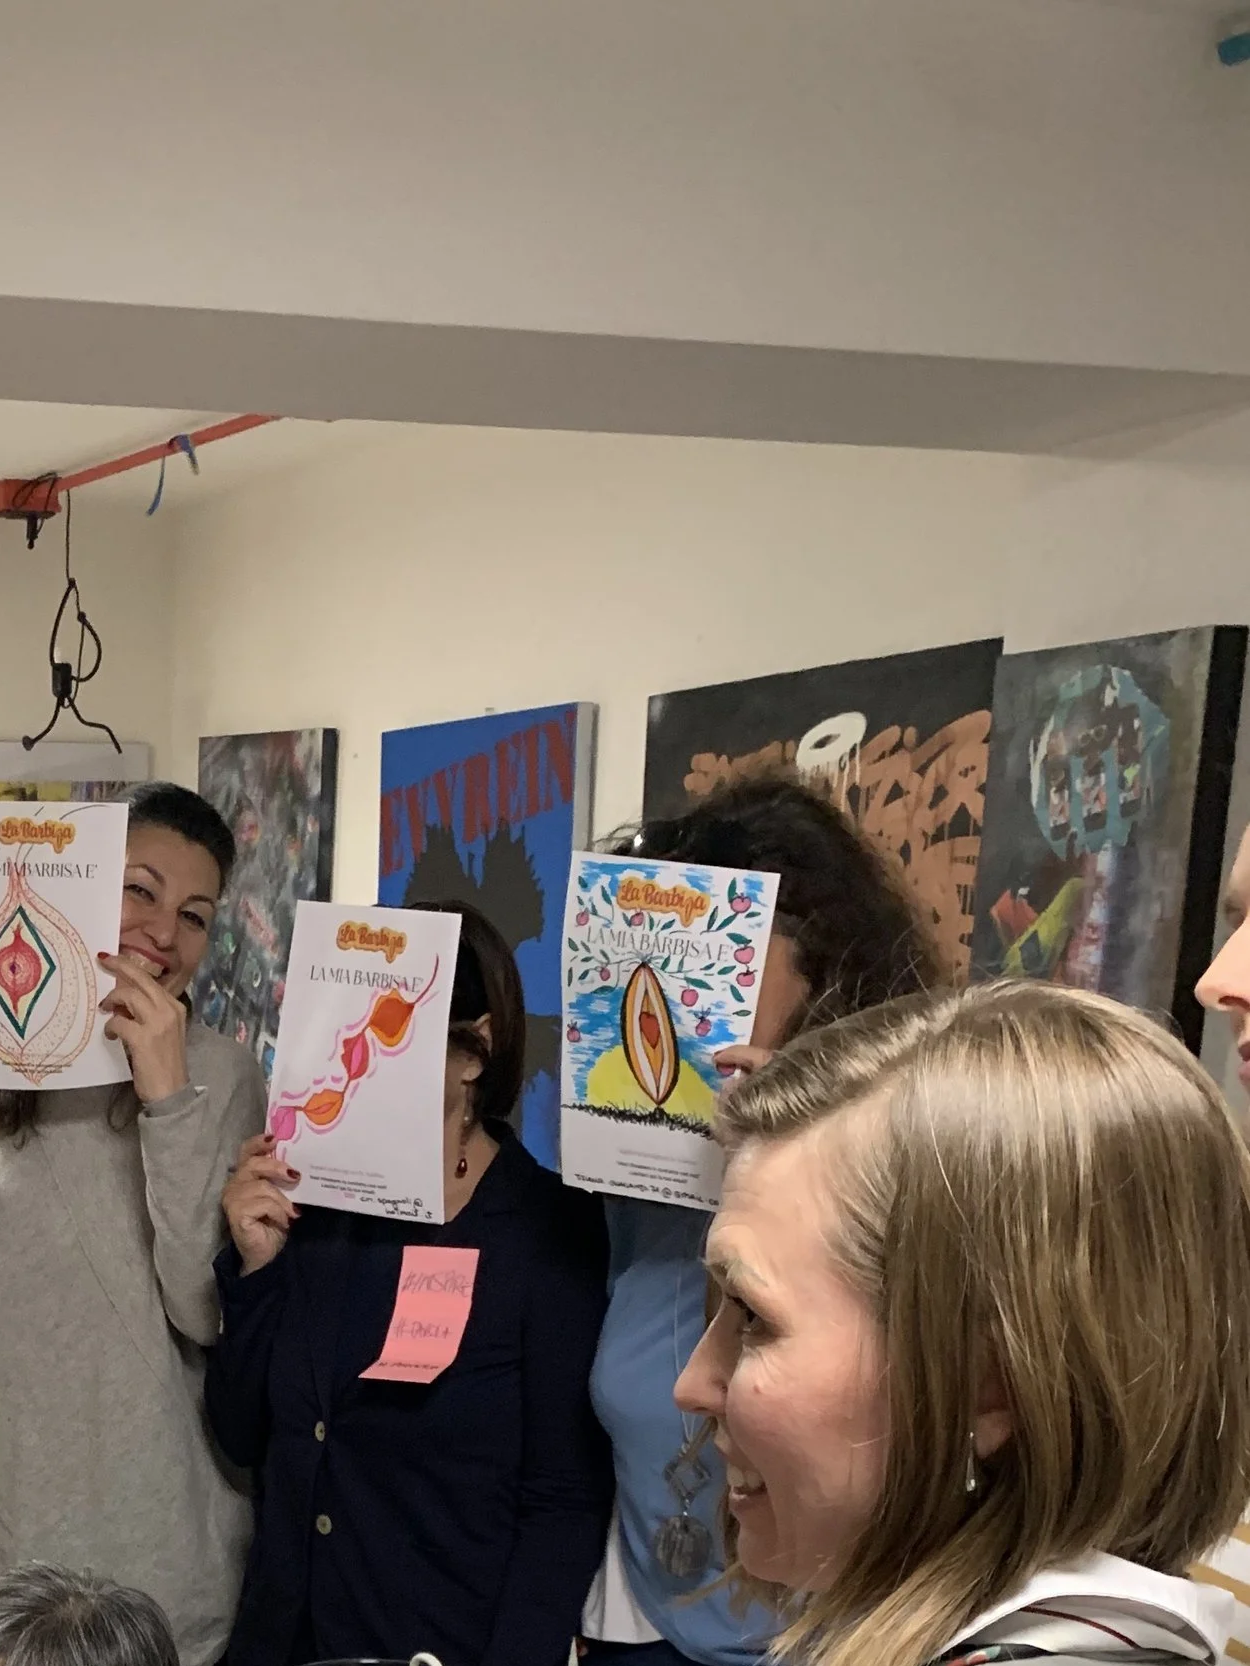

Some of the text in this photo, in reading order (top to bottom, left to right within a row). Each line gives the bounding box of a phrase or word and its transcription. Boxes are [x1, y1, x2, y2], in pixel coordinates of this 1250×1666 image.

[1, 820, 19, 838] La
[23, 862, 82, 878] BARBISA
[621, 880, 640, 901] La
[340, 925, 356, 943] La
[587, 925, 605, 945] LA
[609, 929, 636, 949] MIA
[640, 933, 712, 960] BARBISA
[310, 965, 326, 981] LA
[329, 967, 350, 984] MIA
[353, 969, 409, 992] BARBISA
